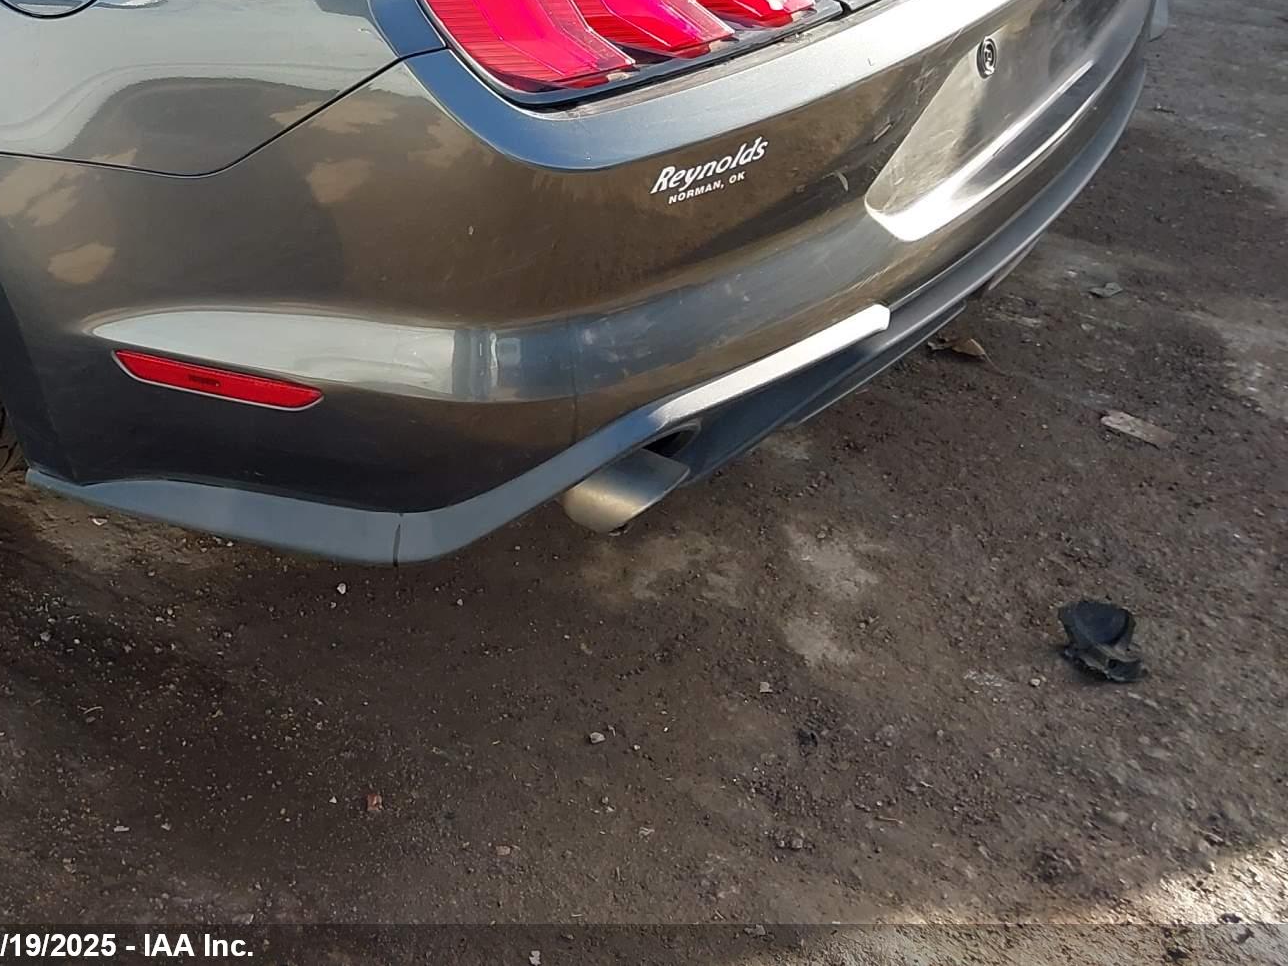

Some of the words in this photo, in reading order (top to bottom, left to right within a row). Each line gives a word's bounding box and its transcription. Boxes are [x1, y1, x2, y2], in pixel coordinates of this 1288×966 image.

[650, 136, 768, 194] Reynolds
[668, 179, 725, 204] NORMAN,
[728, 171, 746, 184] OK
